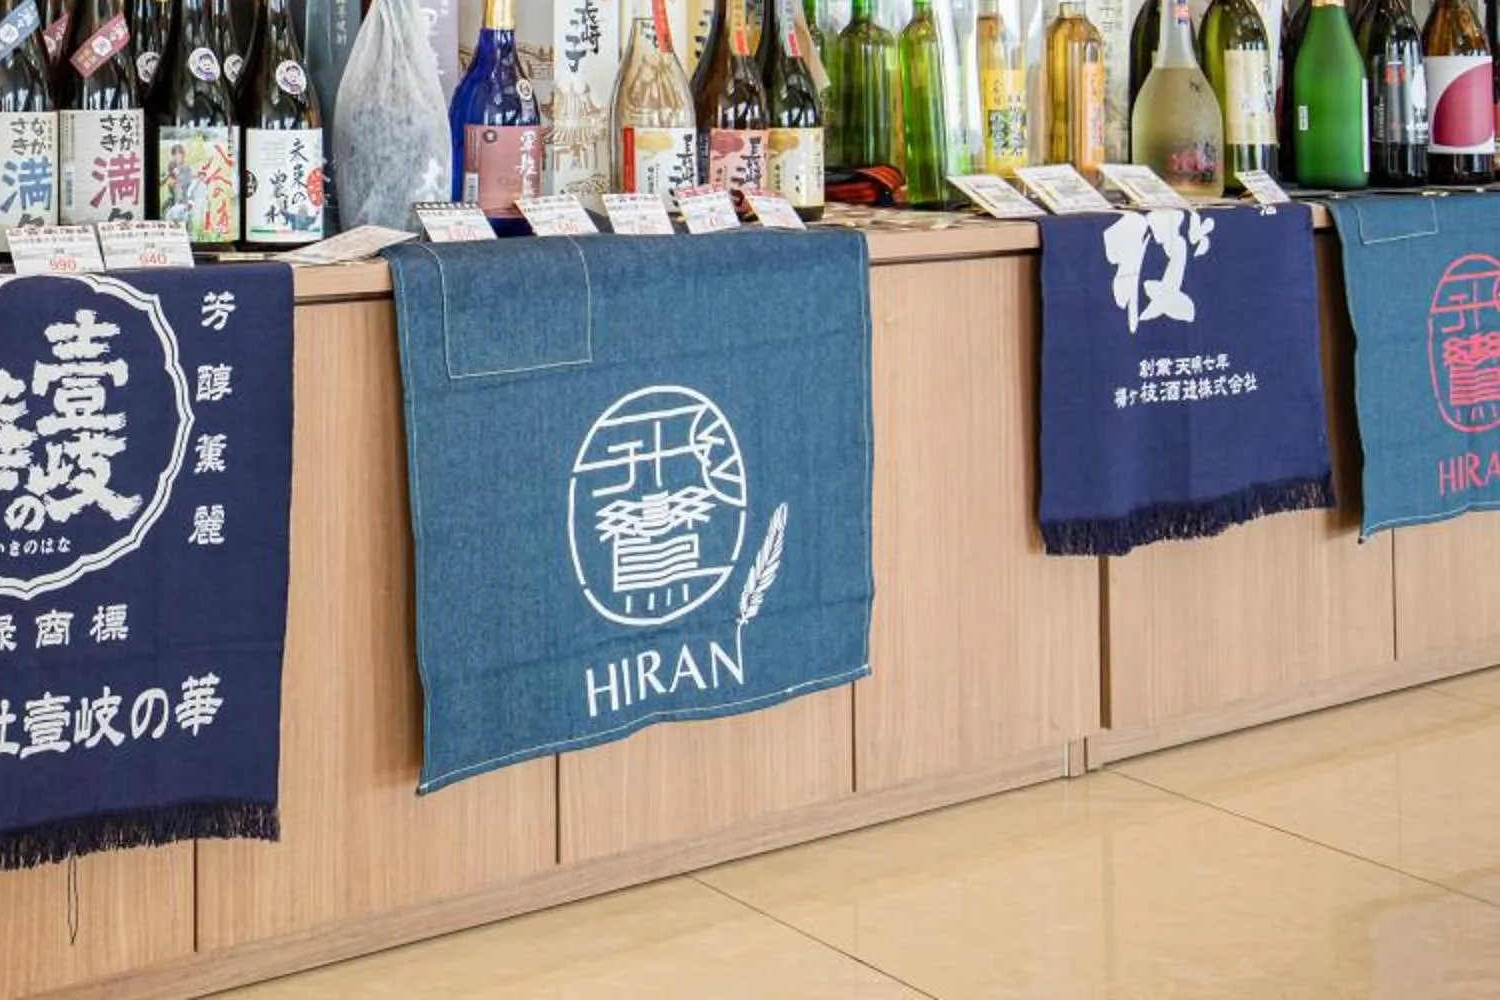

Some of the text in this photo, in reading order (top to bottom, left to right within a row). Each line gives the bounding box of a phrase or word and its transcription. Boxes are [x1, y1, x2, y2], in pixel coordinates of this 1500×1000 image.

[188, 290, 237, 546] 芳醇薫麗
[585, 640, 745, 717] HIRAN
